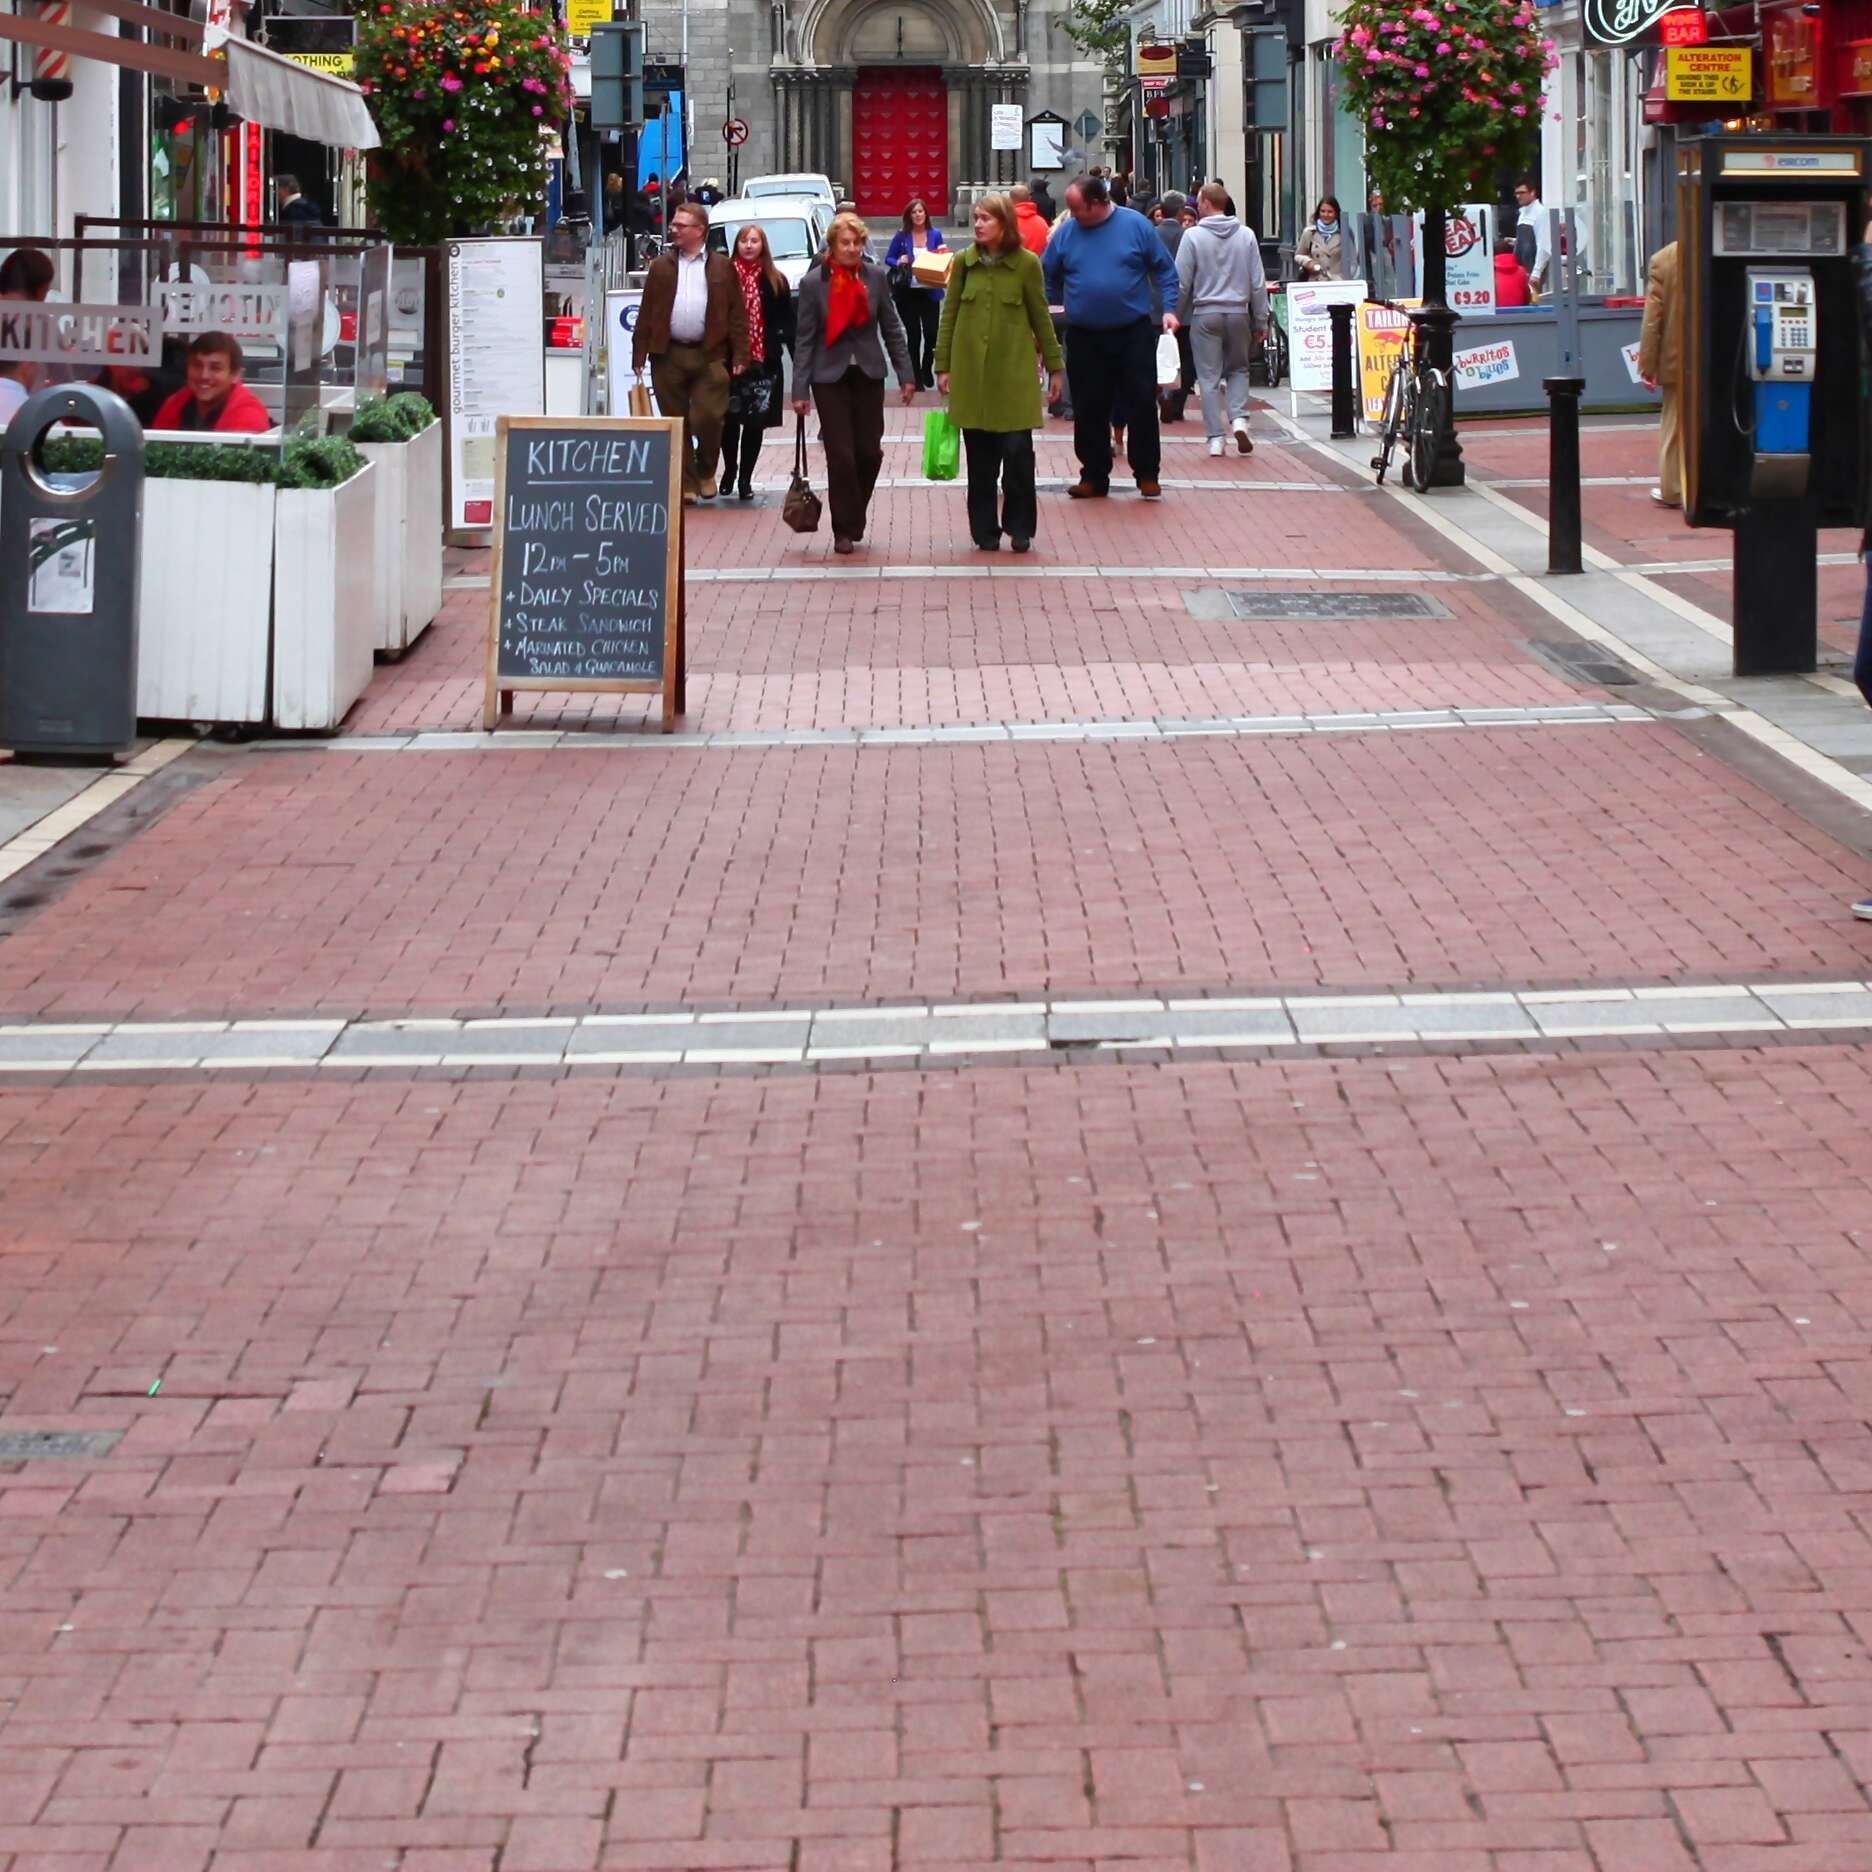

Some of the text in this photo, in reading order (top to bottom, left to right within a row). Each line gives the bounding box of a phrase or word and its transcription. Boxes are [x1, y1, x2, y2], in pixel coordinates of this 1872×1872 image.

[1663, 13, 1699, 26] WINE
[1665, 27, 1702, 43] BAR
[1678, 53, 1742, 63] ALTERATION
[1689, 63, 1731, 72] CENTRE
[0, 311, 150, 355] KITCHEN
[450, 261, 462, 415] gourmet burger kitchen
[528, 439, 651, 476] KITCHEN
[508, 493, 668, 535] LUNCH SERVED
[520, 581, 573, 607] DAILY
[579, 579, 659, 610] SPECIALS
[516, 611, 568, 634] STEAK
[578, 611, 653, 634] SANDWICH
[515, 636, 587, 660] MARINATED
[591, 638, 649, 657] CHICKEN
[529, 657, 571, 675] SALAD
